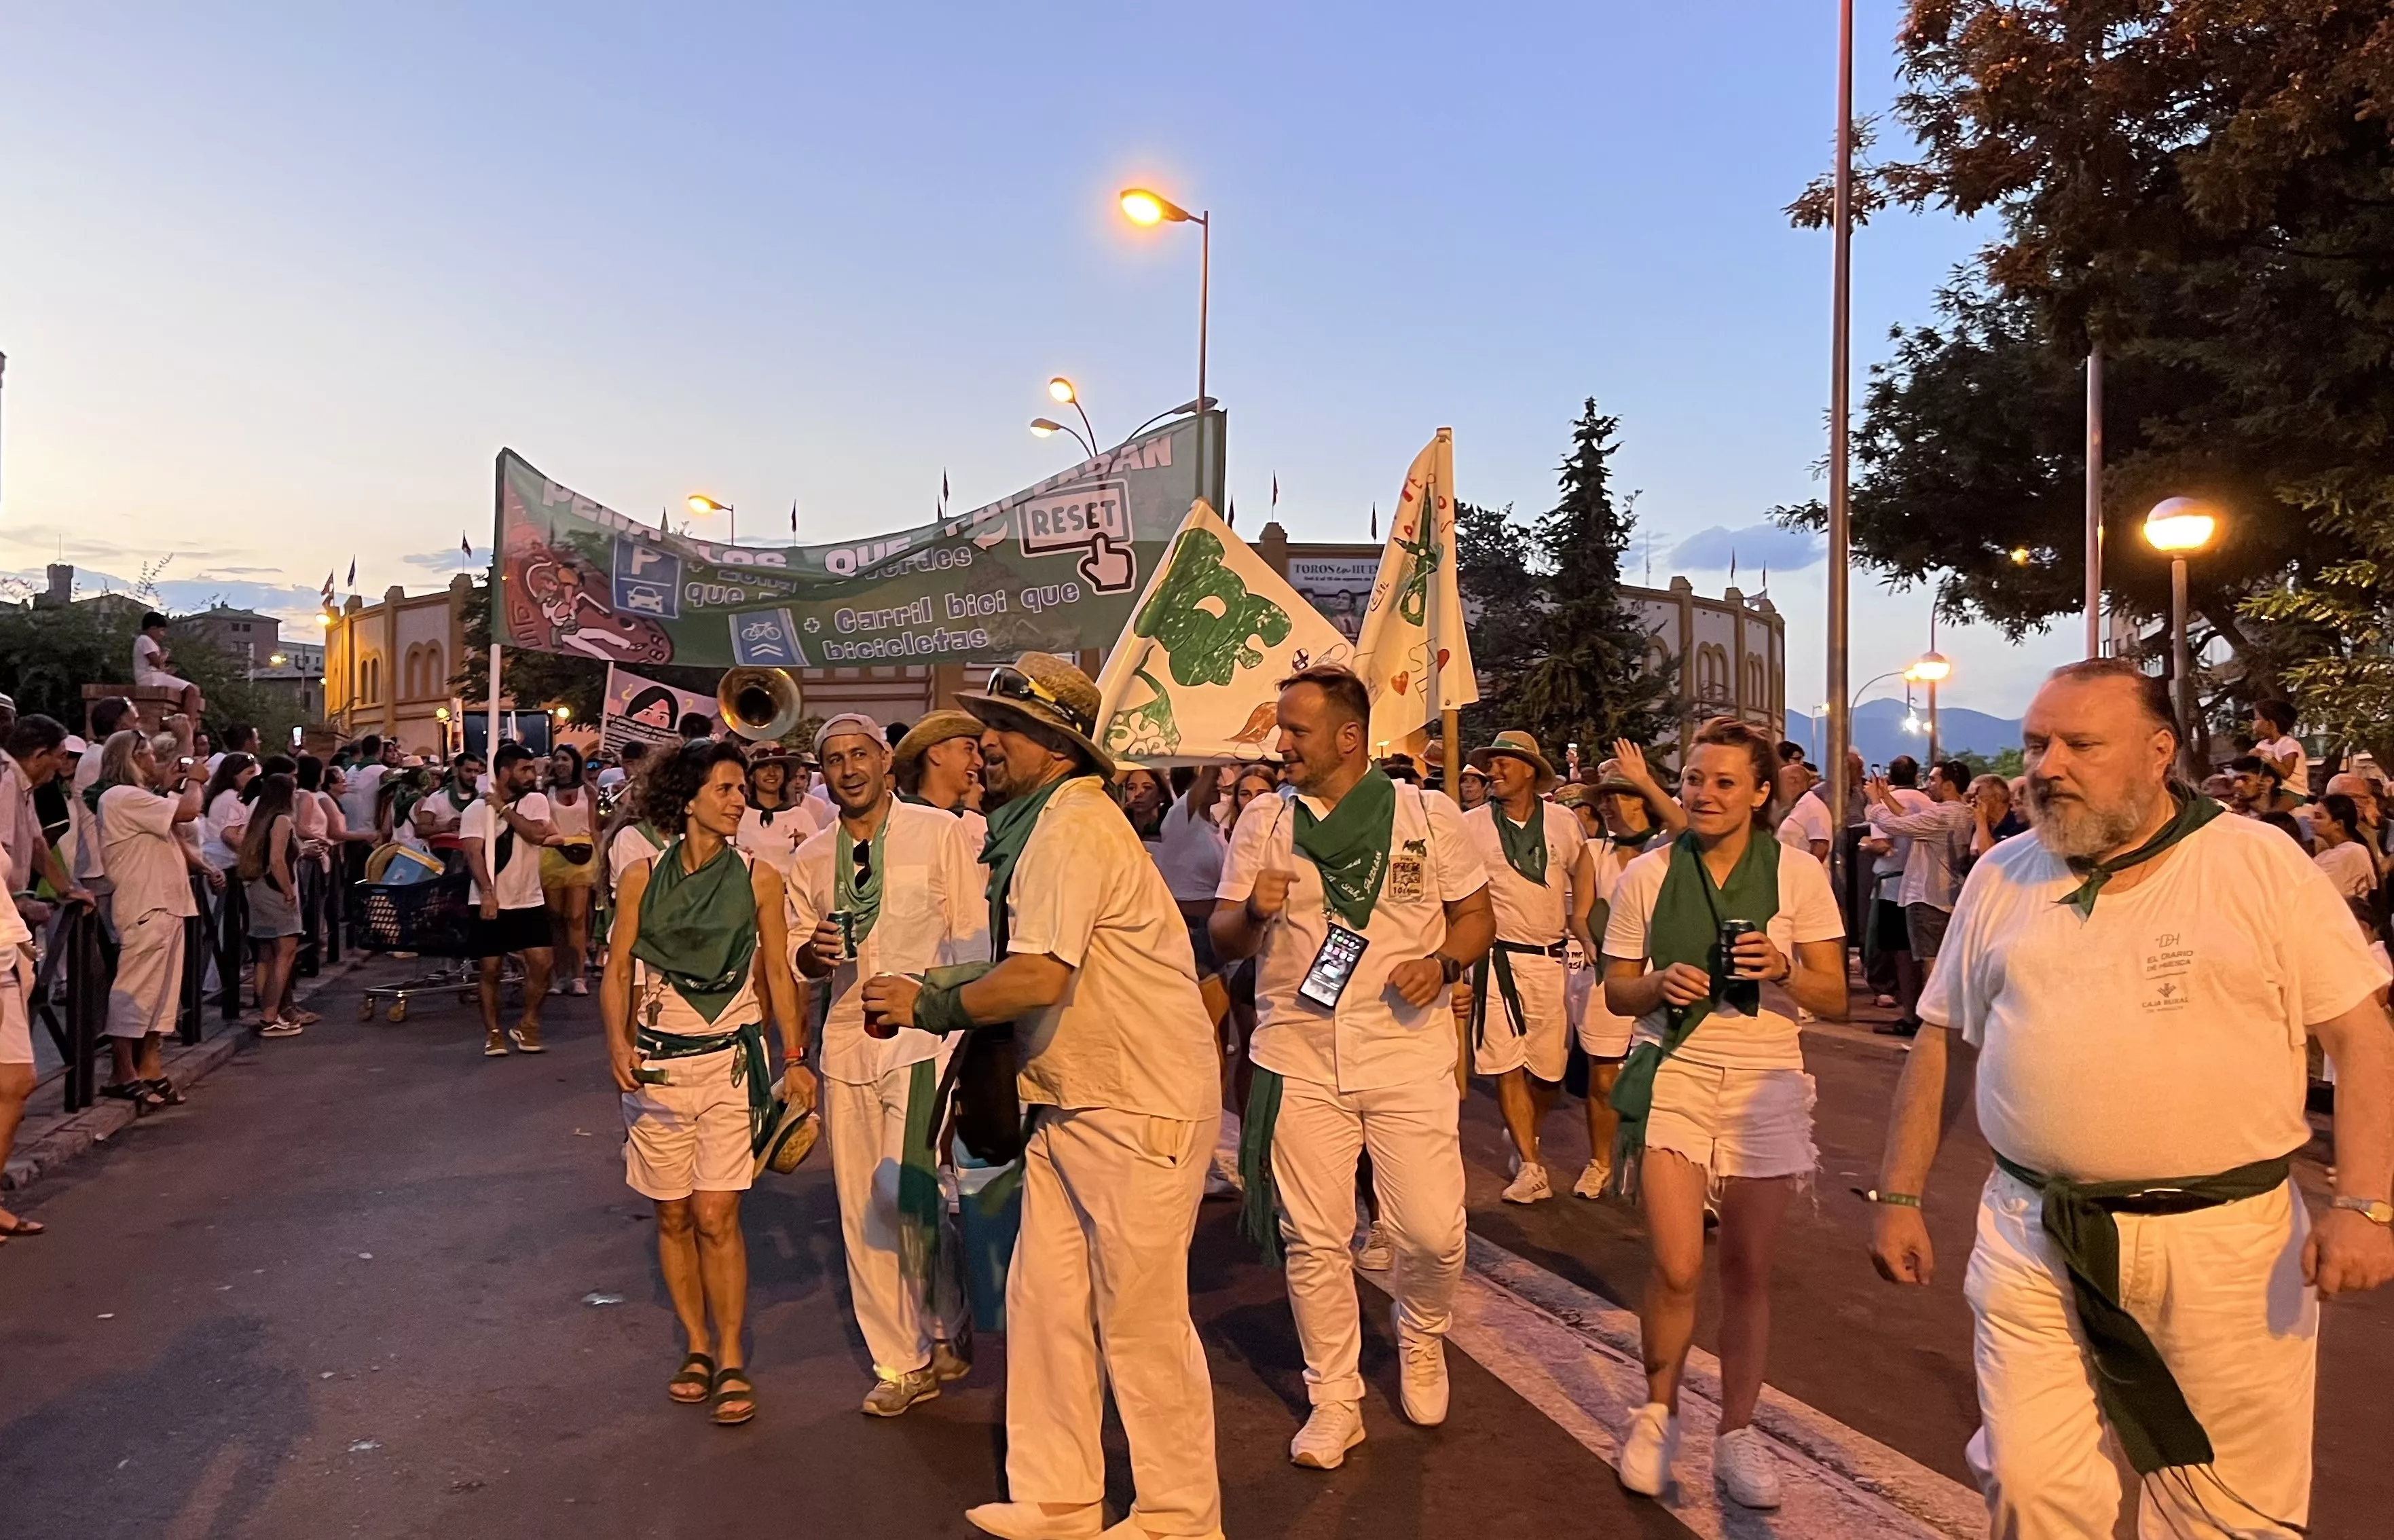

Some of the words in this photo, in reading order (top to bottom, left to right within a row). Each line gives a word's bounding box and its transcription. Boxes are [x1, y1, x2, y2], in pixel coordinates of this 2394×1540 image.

[1031, 500, 1116, 536] RESET
[825, 536, 911, 576] QUE
[864, 547, 972, 579] erdes
[1293, 564, 1335, 574] TOROS
[1352, 565, 1378, 574] HUE
[685, 582, 744, 607] que
[834, 596, 932, 634] Carril
[945, 589, 1006, 619] bici
[1020, 582, 1080, 610] que
[822, 627, 988, 660] bicicletas
[2159, 959, 2191, 968] HUESCA
[2161, 951, 2194, 960] DIARIO
[2164, 997, 2189, 1005] RURAL
